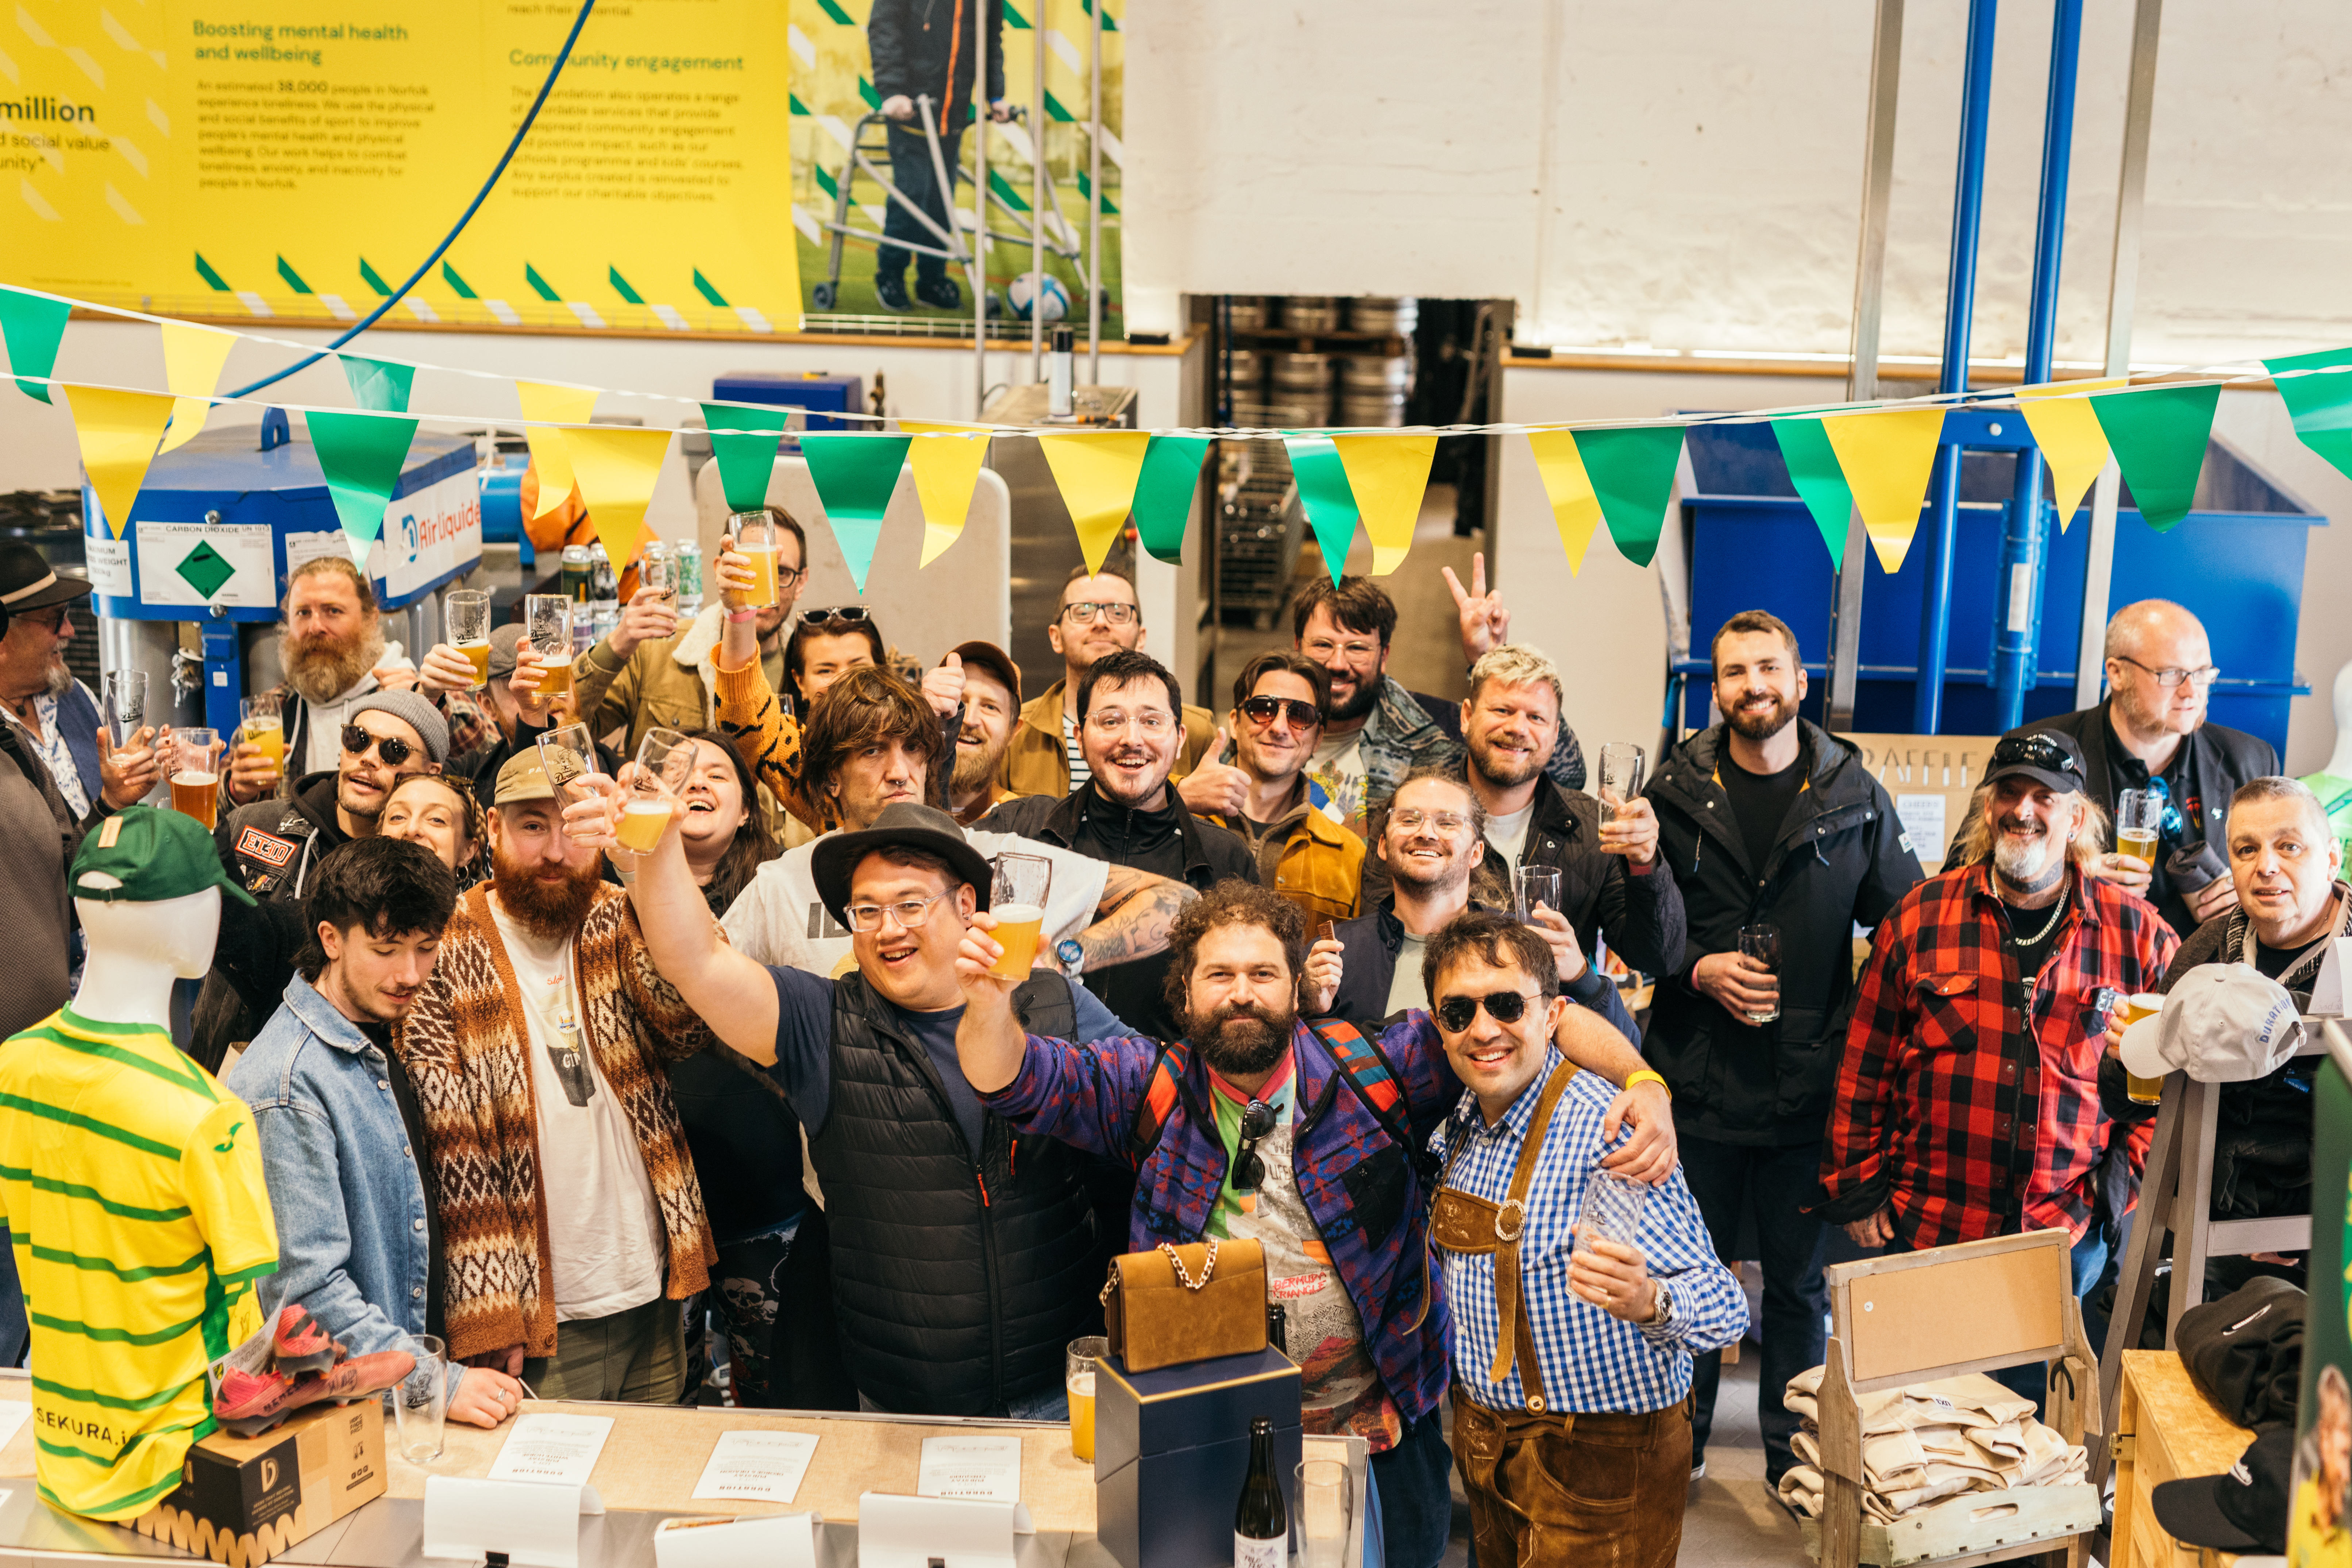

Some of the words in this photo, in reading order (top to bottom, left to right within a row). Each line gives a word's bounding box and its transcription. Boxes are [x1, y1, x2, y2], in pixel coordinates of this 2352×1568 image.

[193, 19, 273, 42] Boosting
[278, 23, 344, 39] mental
[349, 23, 408, 40] health
[195, 43, 229, 59] and
[235, 44, 321, 67] wellbeing
[509, 49, 619, 70] Comunity
[625, 57, 743, 73] engagement
[0, 96, 94, 122] million
[11, 132, 59, 149] social
[66, 134, 110, 151] value
[166, 525, 202, 533] CARBON
[420, 518, 437, 550] Air
[97, 557, 127, 565] WEIGHT
[554, 771, 581, 783] Duration
[2259, 997, 2292, 1043] DURATION
[1269, 1280, 1327, 1299] TRIANGLE
[1272, 1271, 1327, 1291] BERMUDA
[349, 1413, 362, 1424] HOPS
